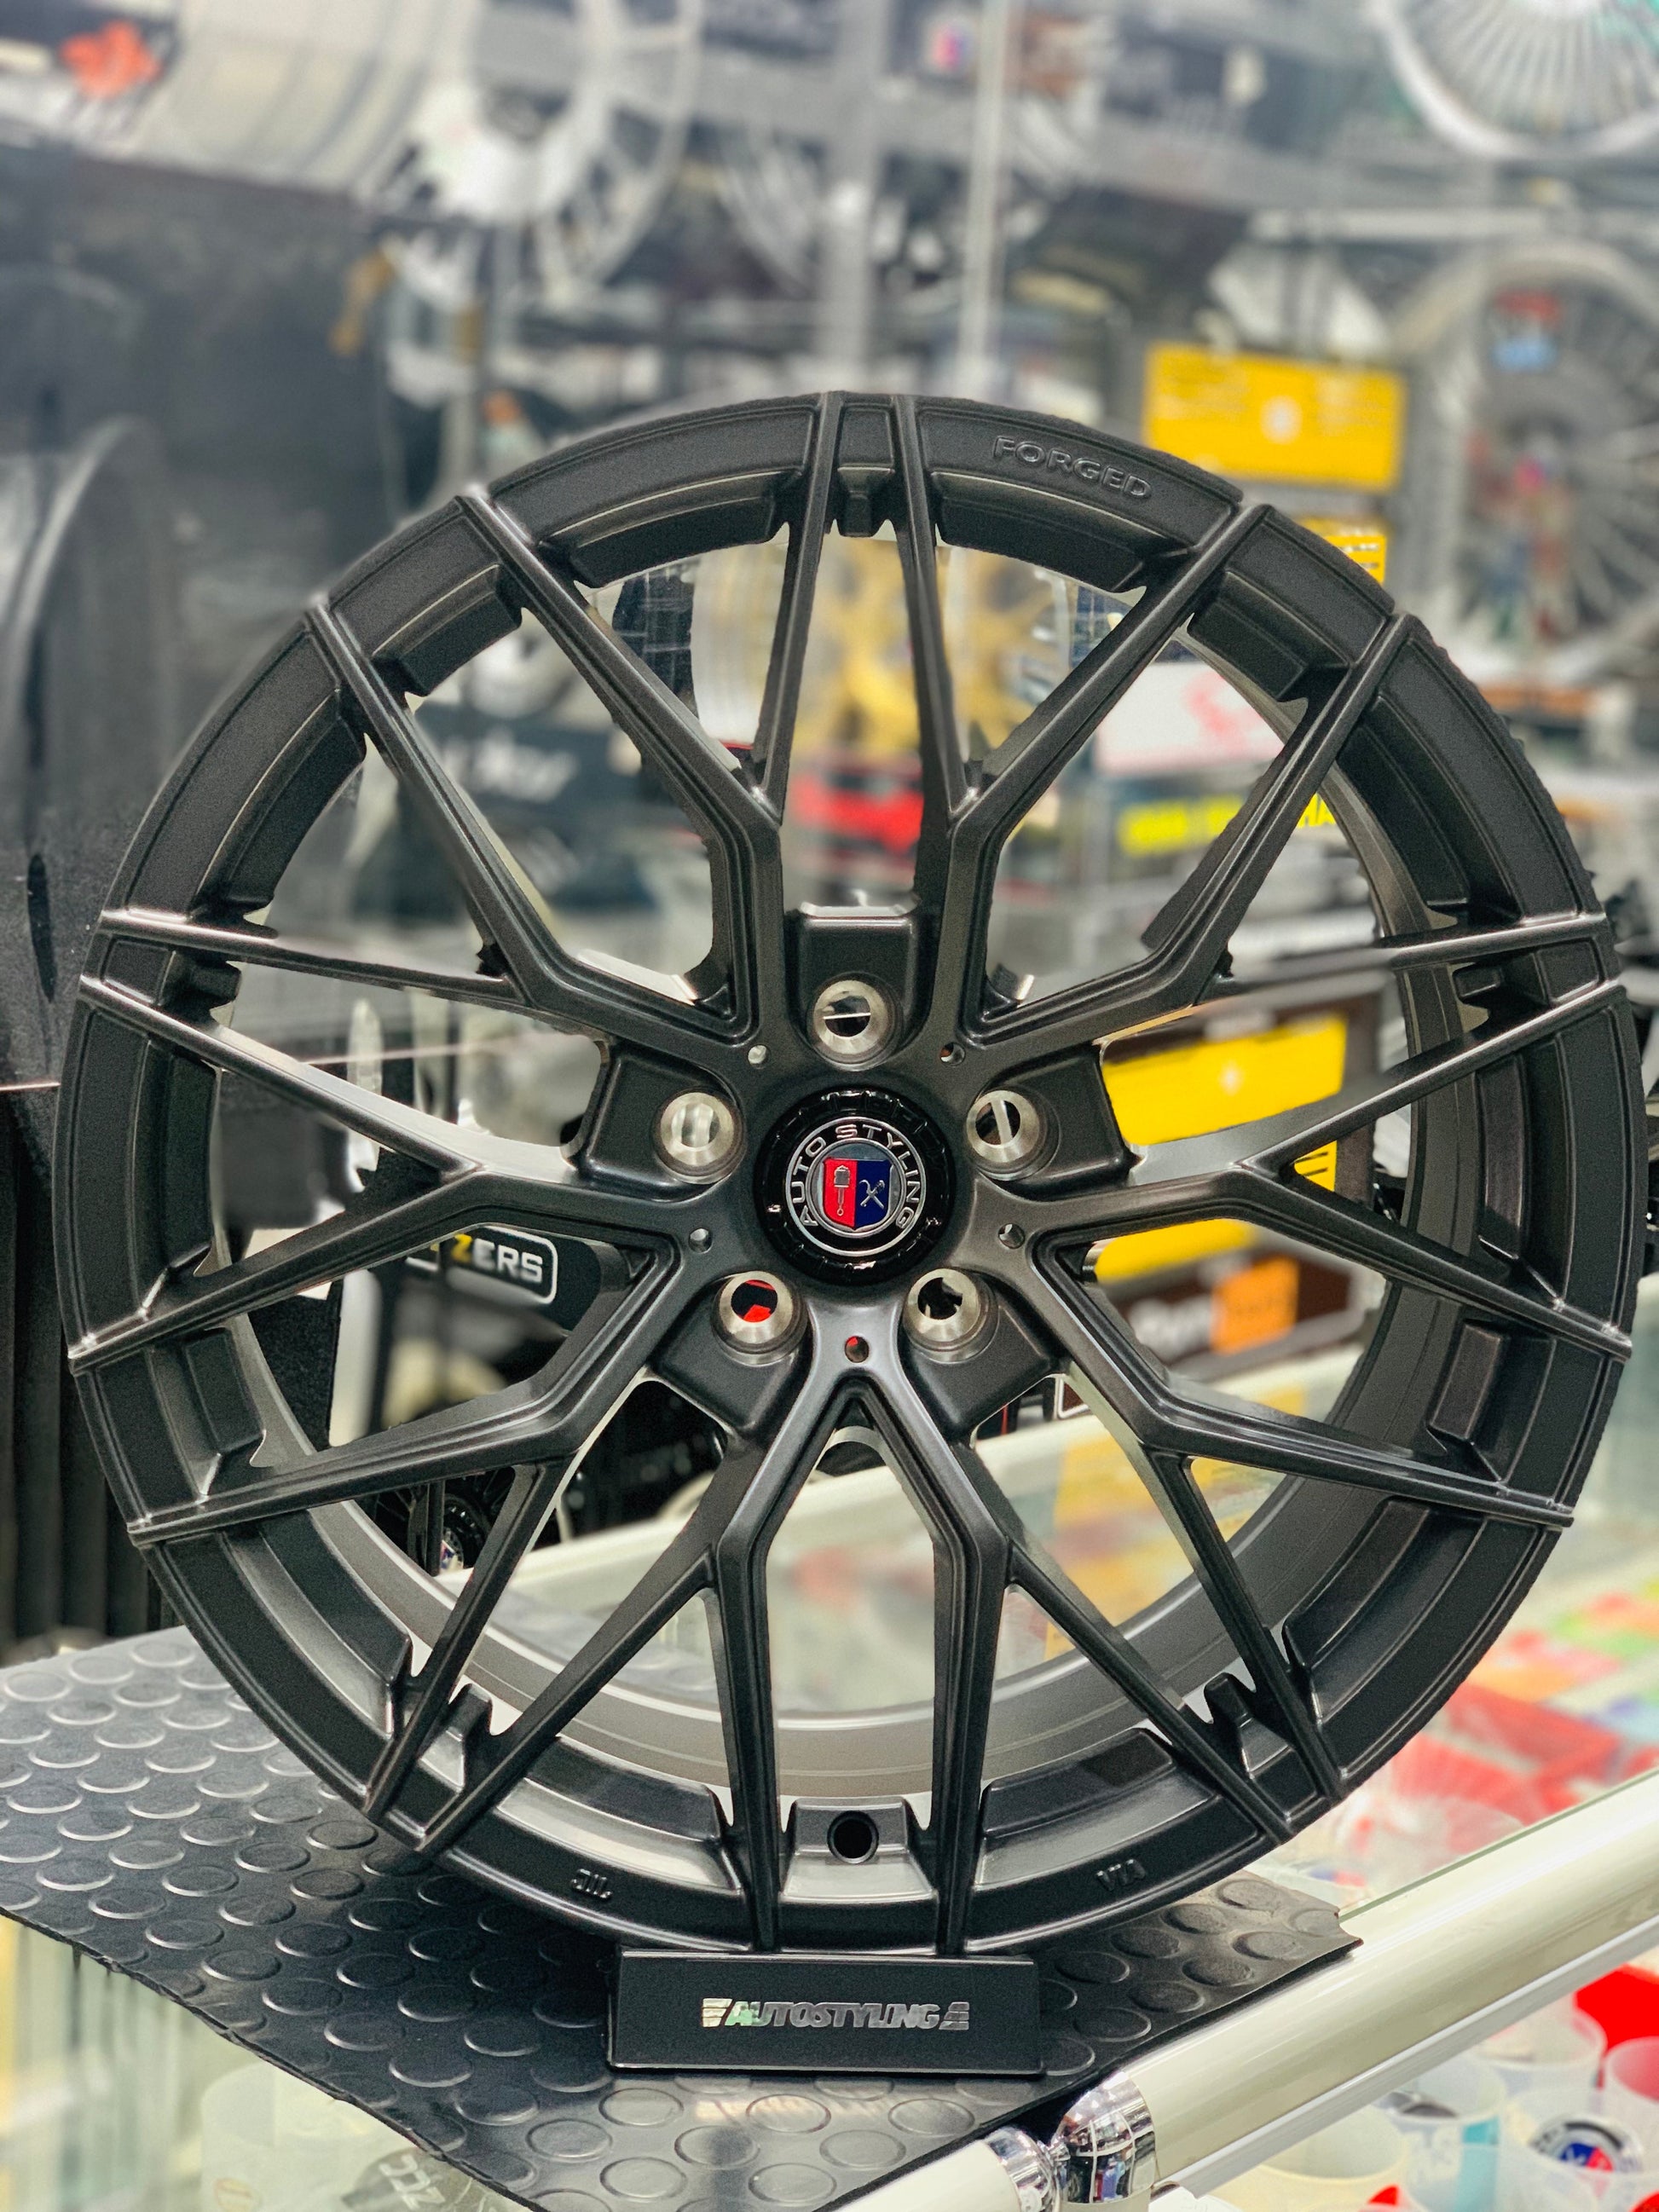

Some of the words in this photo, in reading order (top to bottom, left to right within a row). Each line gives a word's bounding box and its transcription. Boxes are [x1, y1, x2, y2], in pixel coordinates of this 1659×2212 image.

[993, 435, 1152, 498] FORGED
[791, 1136, 827, 1226] AUTO
[835, 1123, 921, 1229] STYLING
[725, 2001, 940, 2030] AUTOSTYLING
